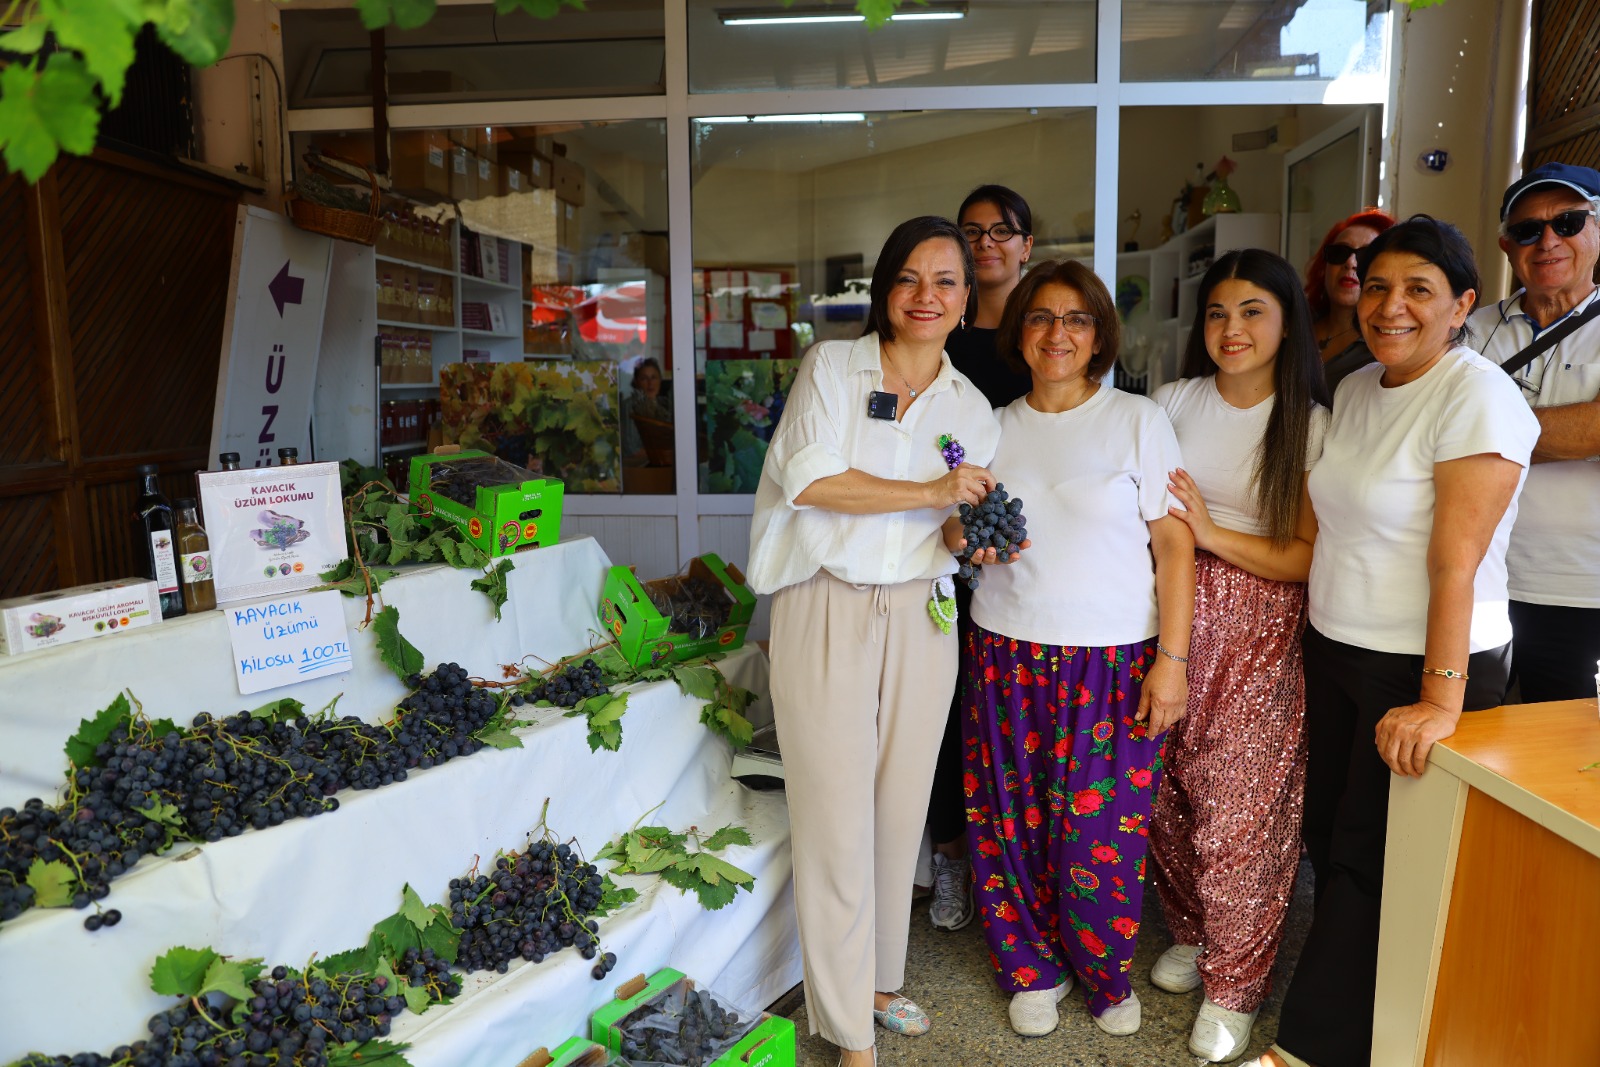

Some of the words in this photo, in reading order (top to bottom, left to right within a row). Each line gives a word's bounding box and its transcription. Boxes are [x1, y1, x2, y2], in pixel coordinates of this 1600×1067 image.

[251, 482, 296, 495] KAVACIK
[234, 495, 267, 509] ÜZÜM
[269, 491, 314, 505] LOKUMU
[68, 608, 96, 619] KAVACIK
[97, 604, 116, 613] ÜZÜM
[116, 599, 144, 610] AROMALI
[113, 606, 136, 616] LOKUM
[234, 601, 303, 626] KAVACIK
[300, 642, 349, 663] 100TL
